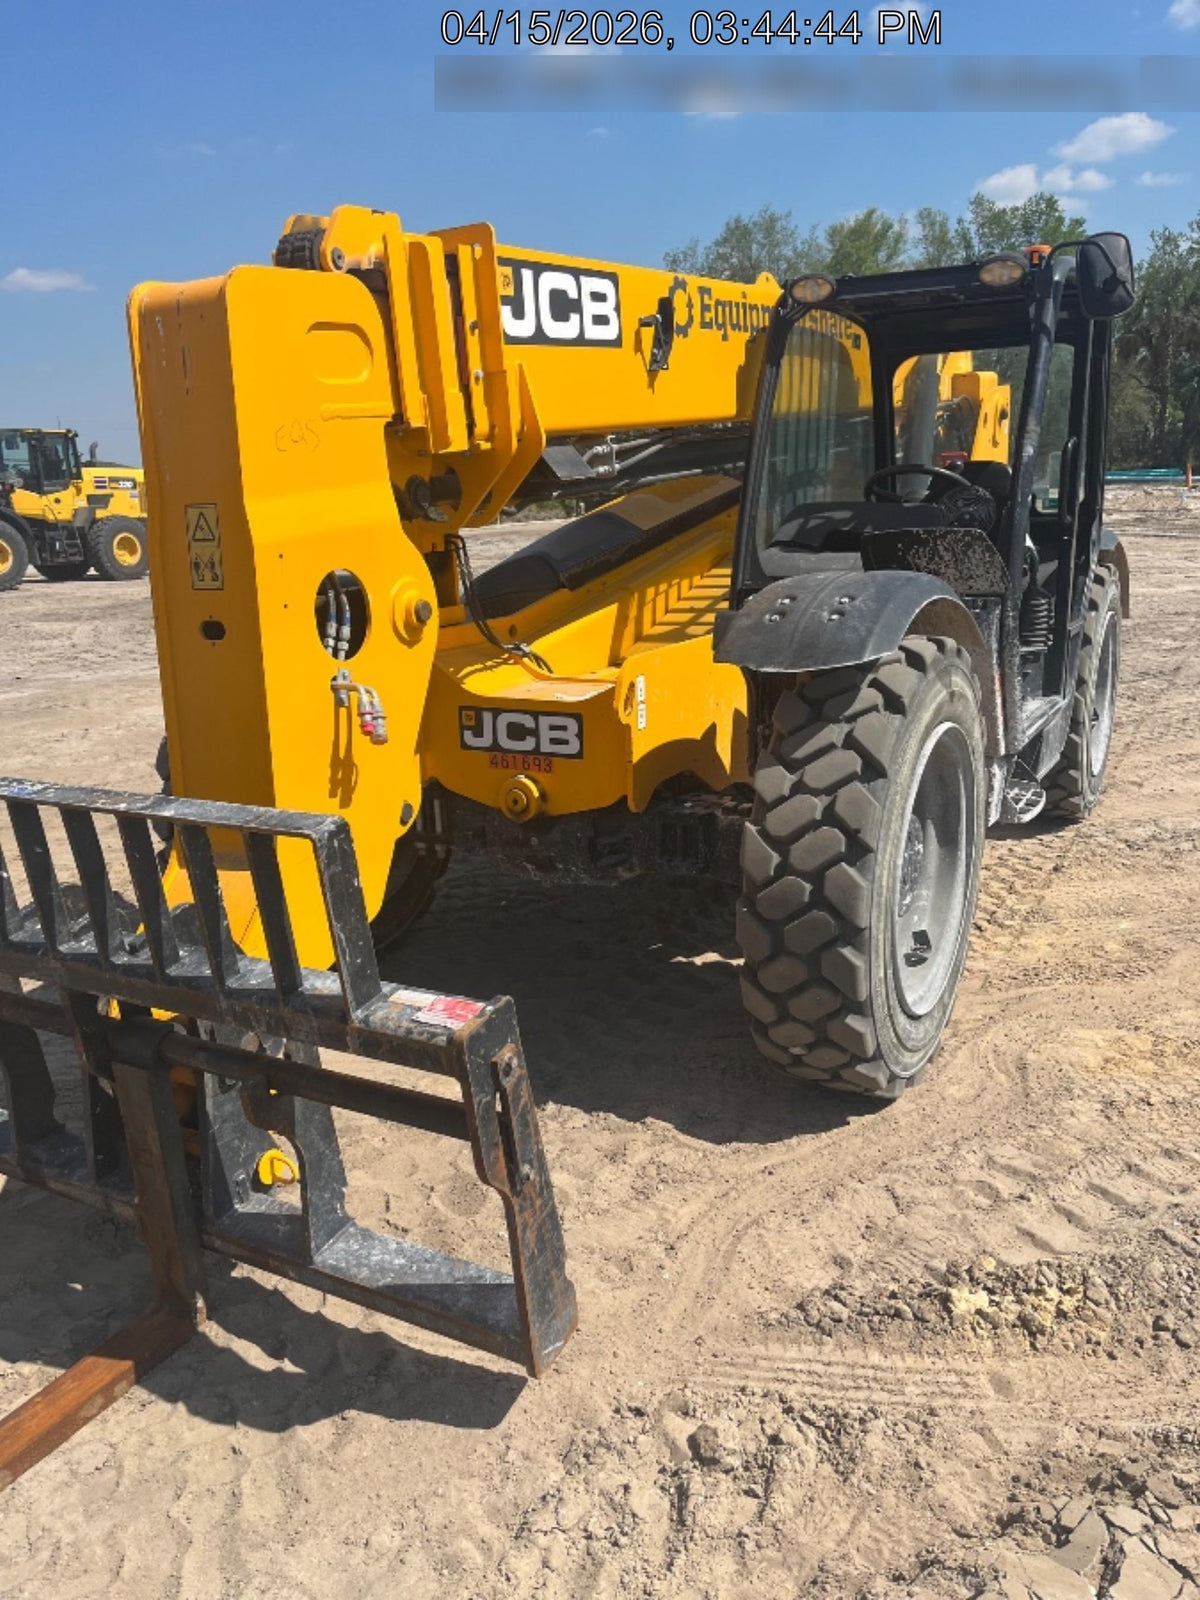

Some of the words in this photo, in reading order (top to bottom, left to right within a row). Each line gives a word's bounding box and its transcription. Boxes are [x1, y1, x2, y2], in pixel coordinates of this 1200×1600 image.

[501, 267, 620, 341] JCB
[463, 711, 581, 755] JCB
[489, 753, 553, 774] 461693
